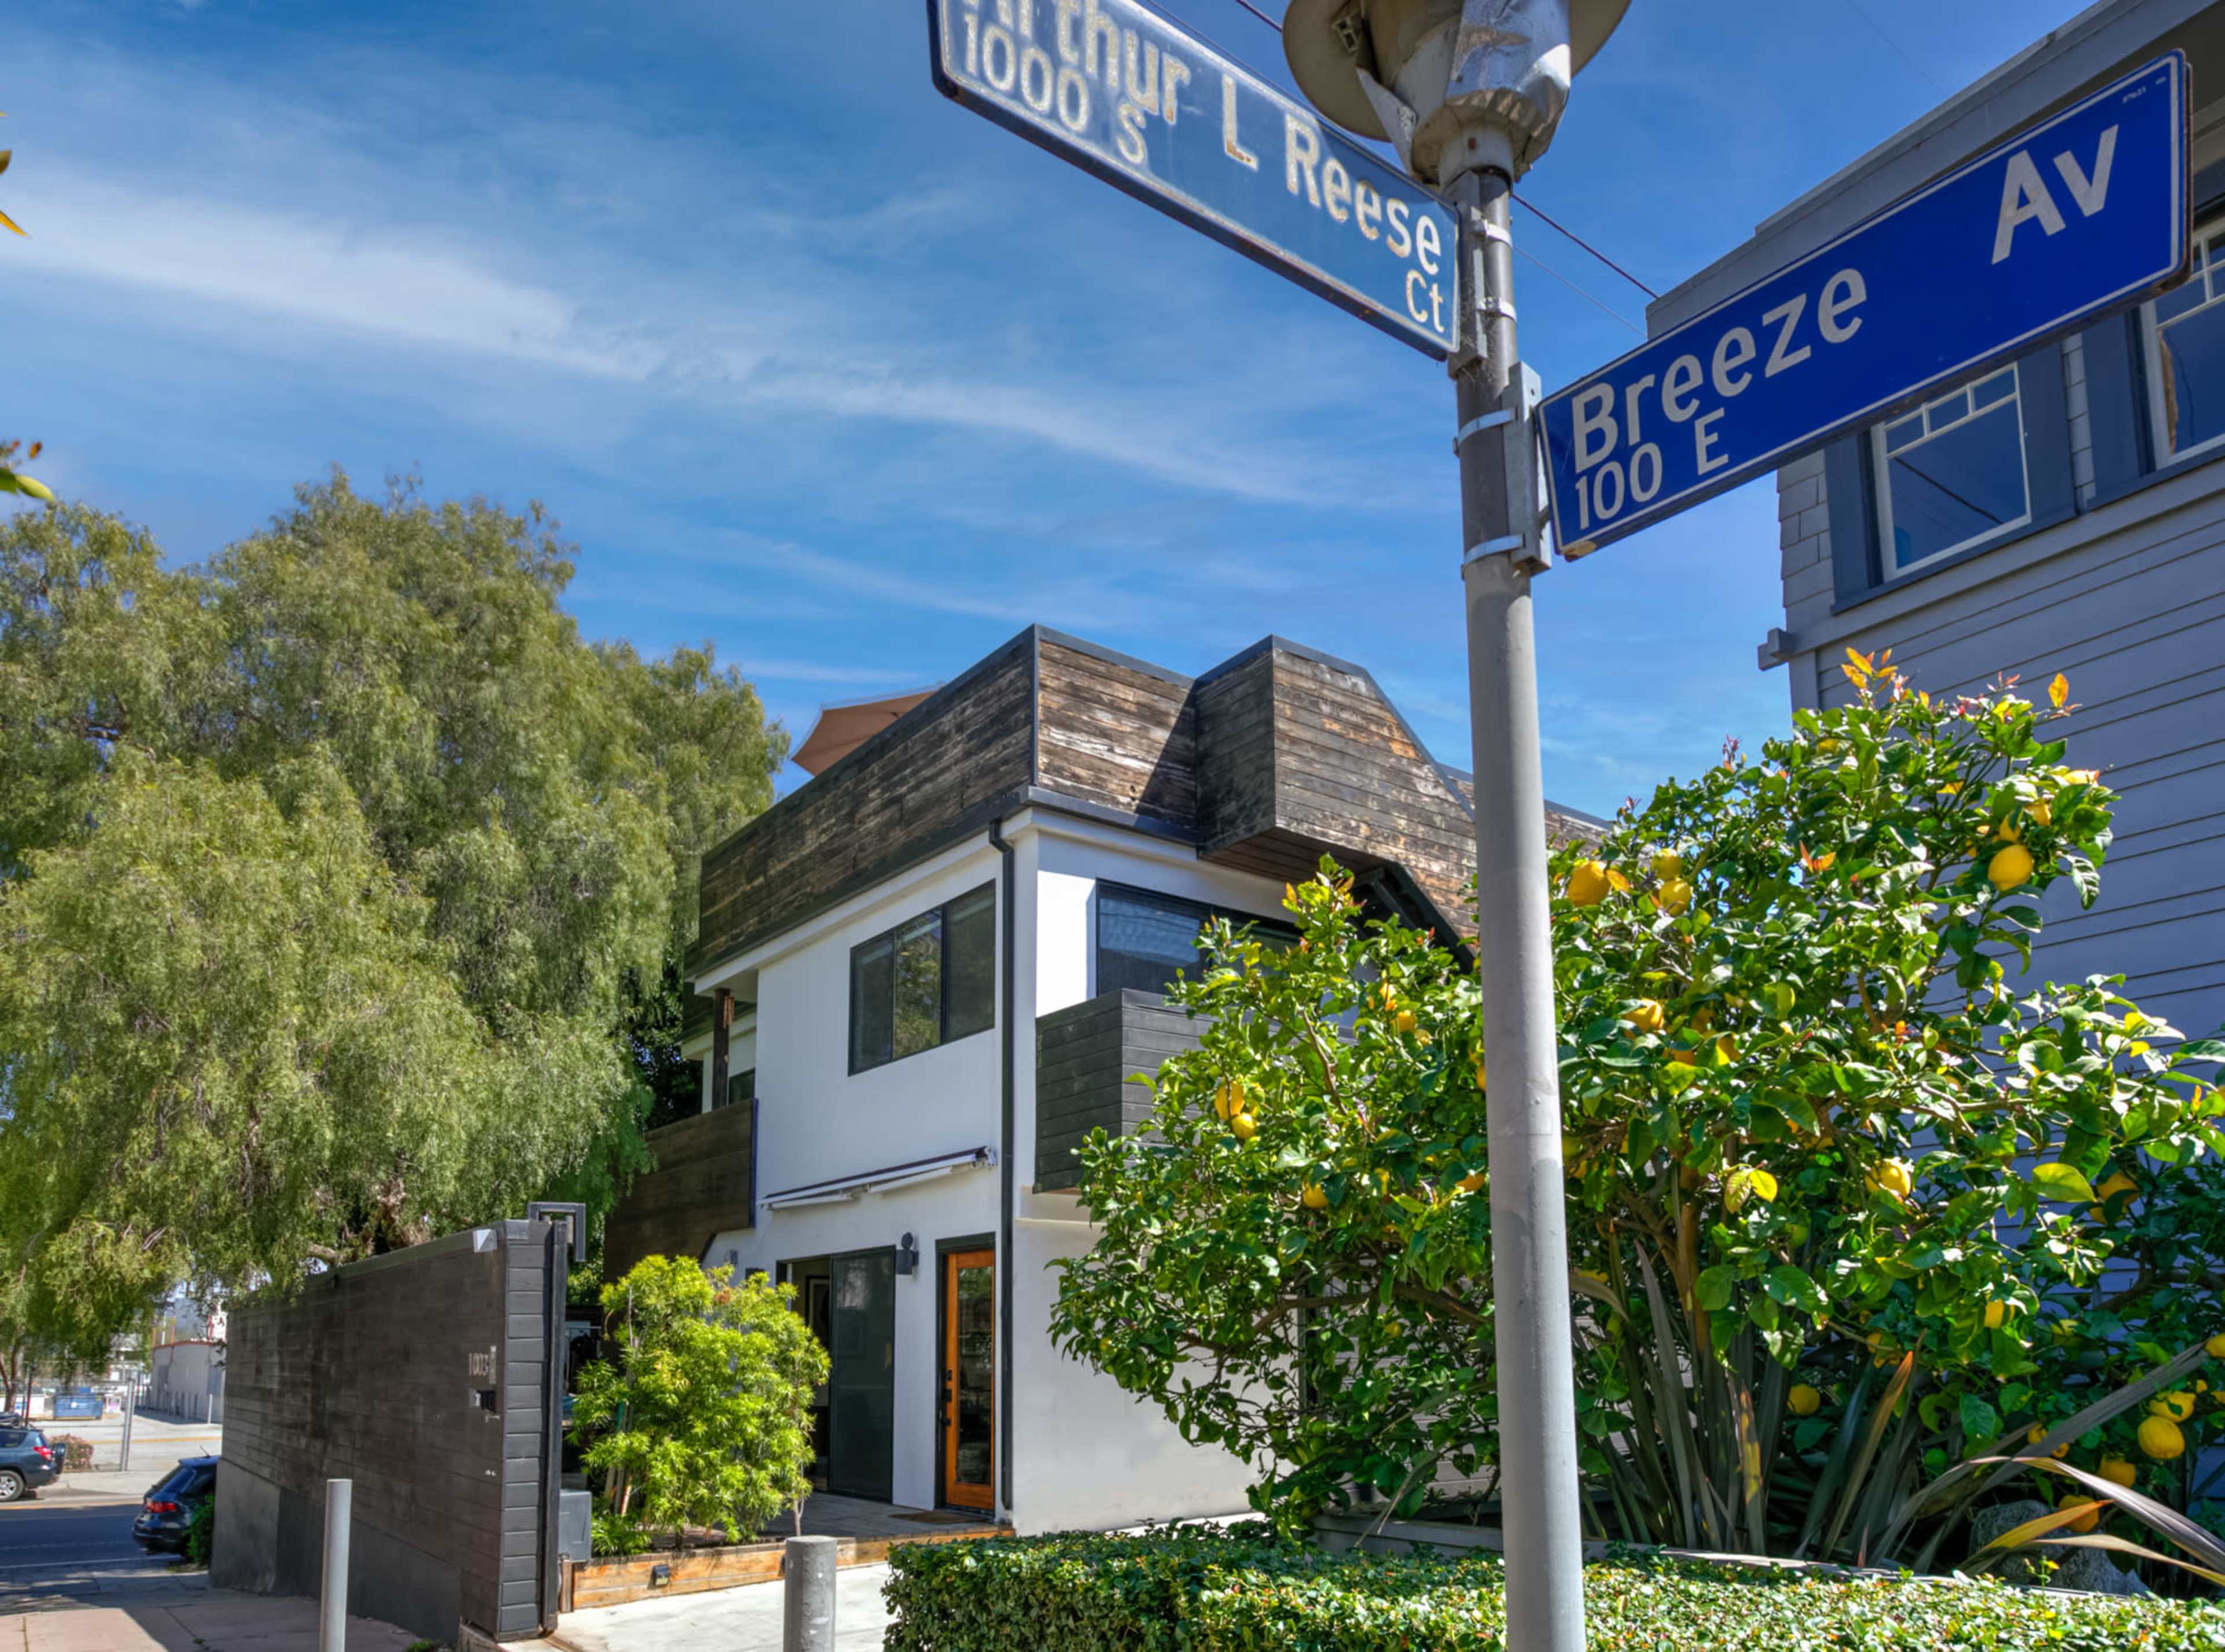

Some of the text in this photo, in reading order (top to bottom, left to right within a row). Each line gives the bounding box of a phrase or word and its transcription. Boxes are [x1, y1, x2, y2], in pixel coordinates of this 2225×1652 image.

[964, 13, 1146, 165] 1000 S
[966, 0, 1442, 276] thur L Reese
[1406, 268, 1445, 333] Ct
[1571, 125, 2118, 474] Breeze Av
[1575, 407, 1729, 530] 100 E
